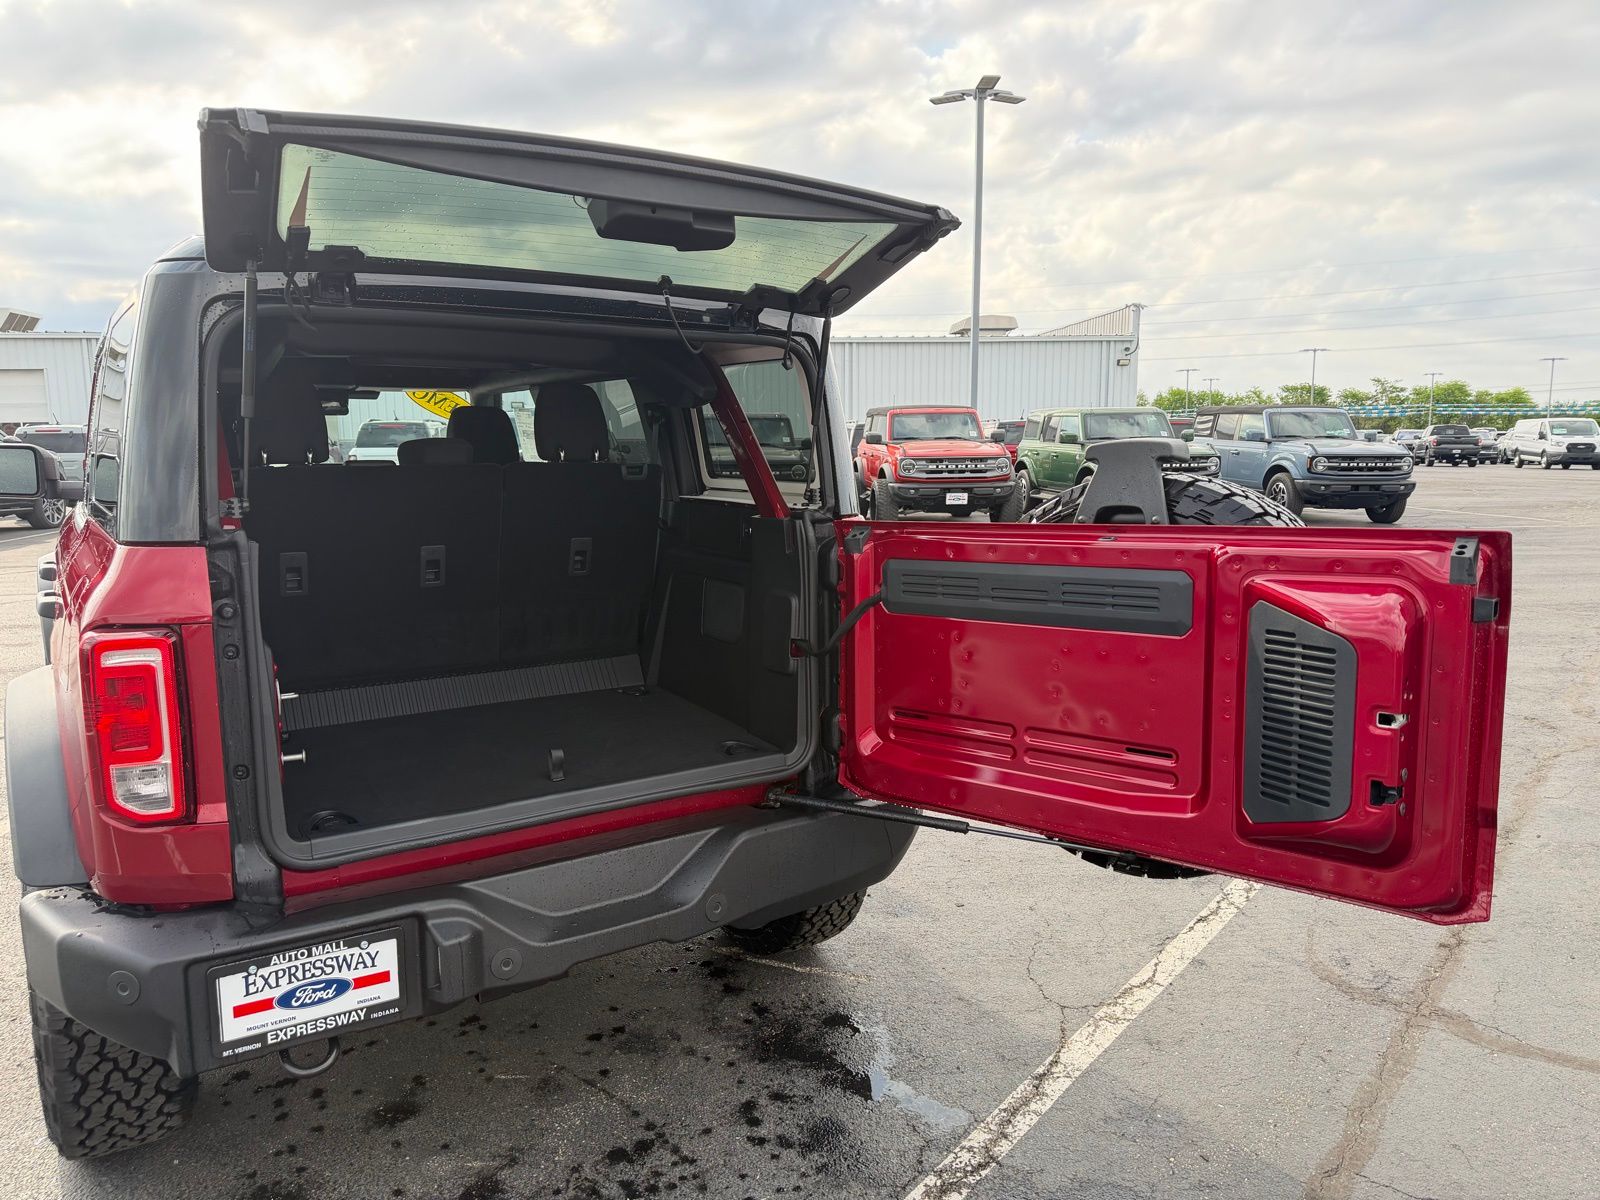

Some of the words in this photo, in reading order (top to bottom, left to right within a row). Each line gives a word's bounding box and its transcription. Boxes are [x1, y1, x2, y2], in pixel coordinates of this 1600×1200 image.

[270, 949, 308, 966] AUTO
[312, 941, 348, 957] MALL
[242, 950, 380, 997] EXPRESSWAY
[291, 983, 337, 1008] Ford
[356, 995, 382, 1005] INDIANA
[235, 1042, 262, 1054] VERNON
[267, 1008, 368, 1045] EXPRESSWAY
[370, 1007, 400, 1019] INDIANA
[246, 1021, 269, 1032] MOUNT
[270, 1015, 297, 1027] VERNON
